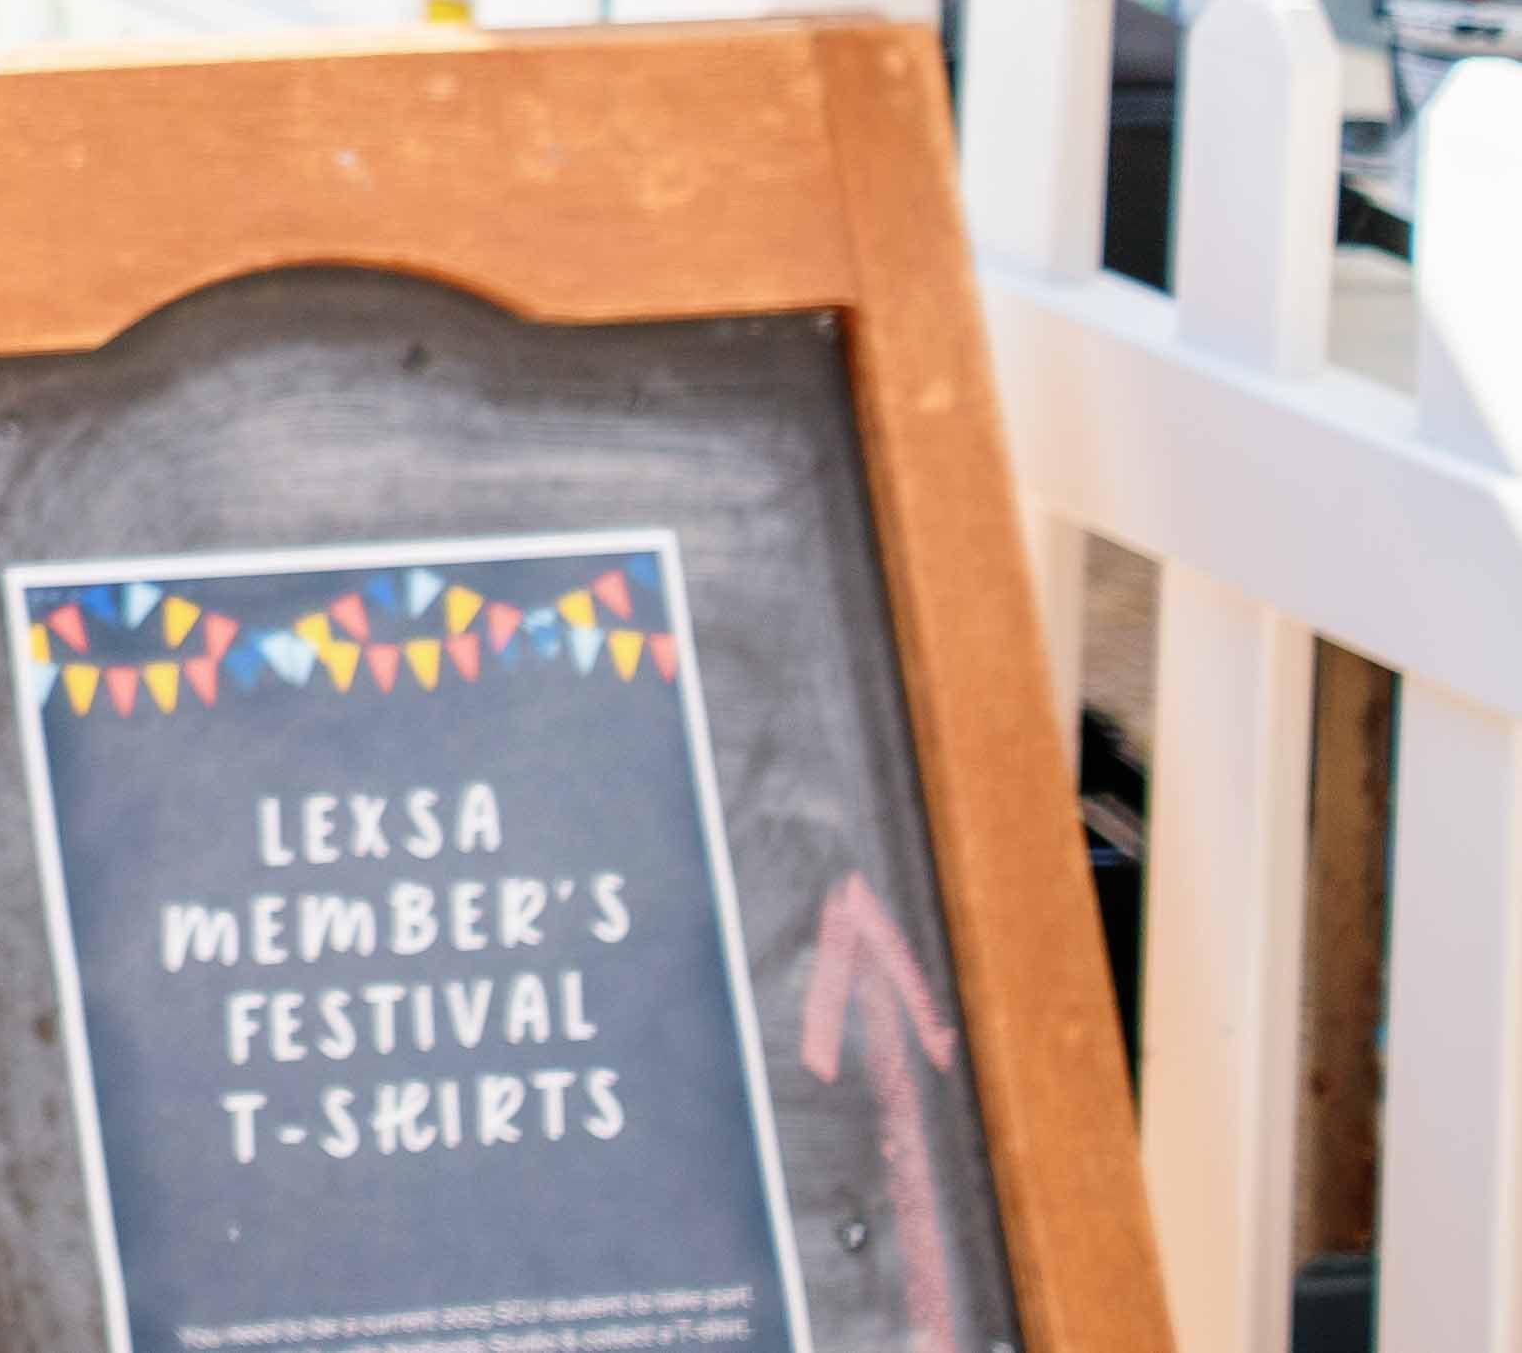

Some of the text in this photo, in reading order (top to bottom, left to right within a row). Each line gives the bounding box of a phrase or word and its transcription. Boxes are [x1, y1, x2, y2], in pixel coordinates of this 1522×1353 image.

[258, 782, 503, 868] LEXSA
[160, 873, 632, 975] MEMBER'S
[227, 970, 597, 1066] FESTIVAL
[222, 1068, 625, 1164] T-SHIRTS
